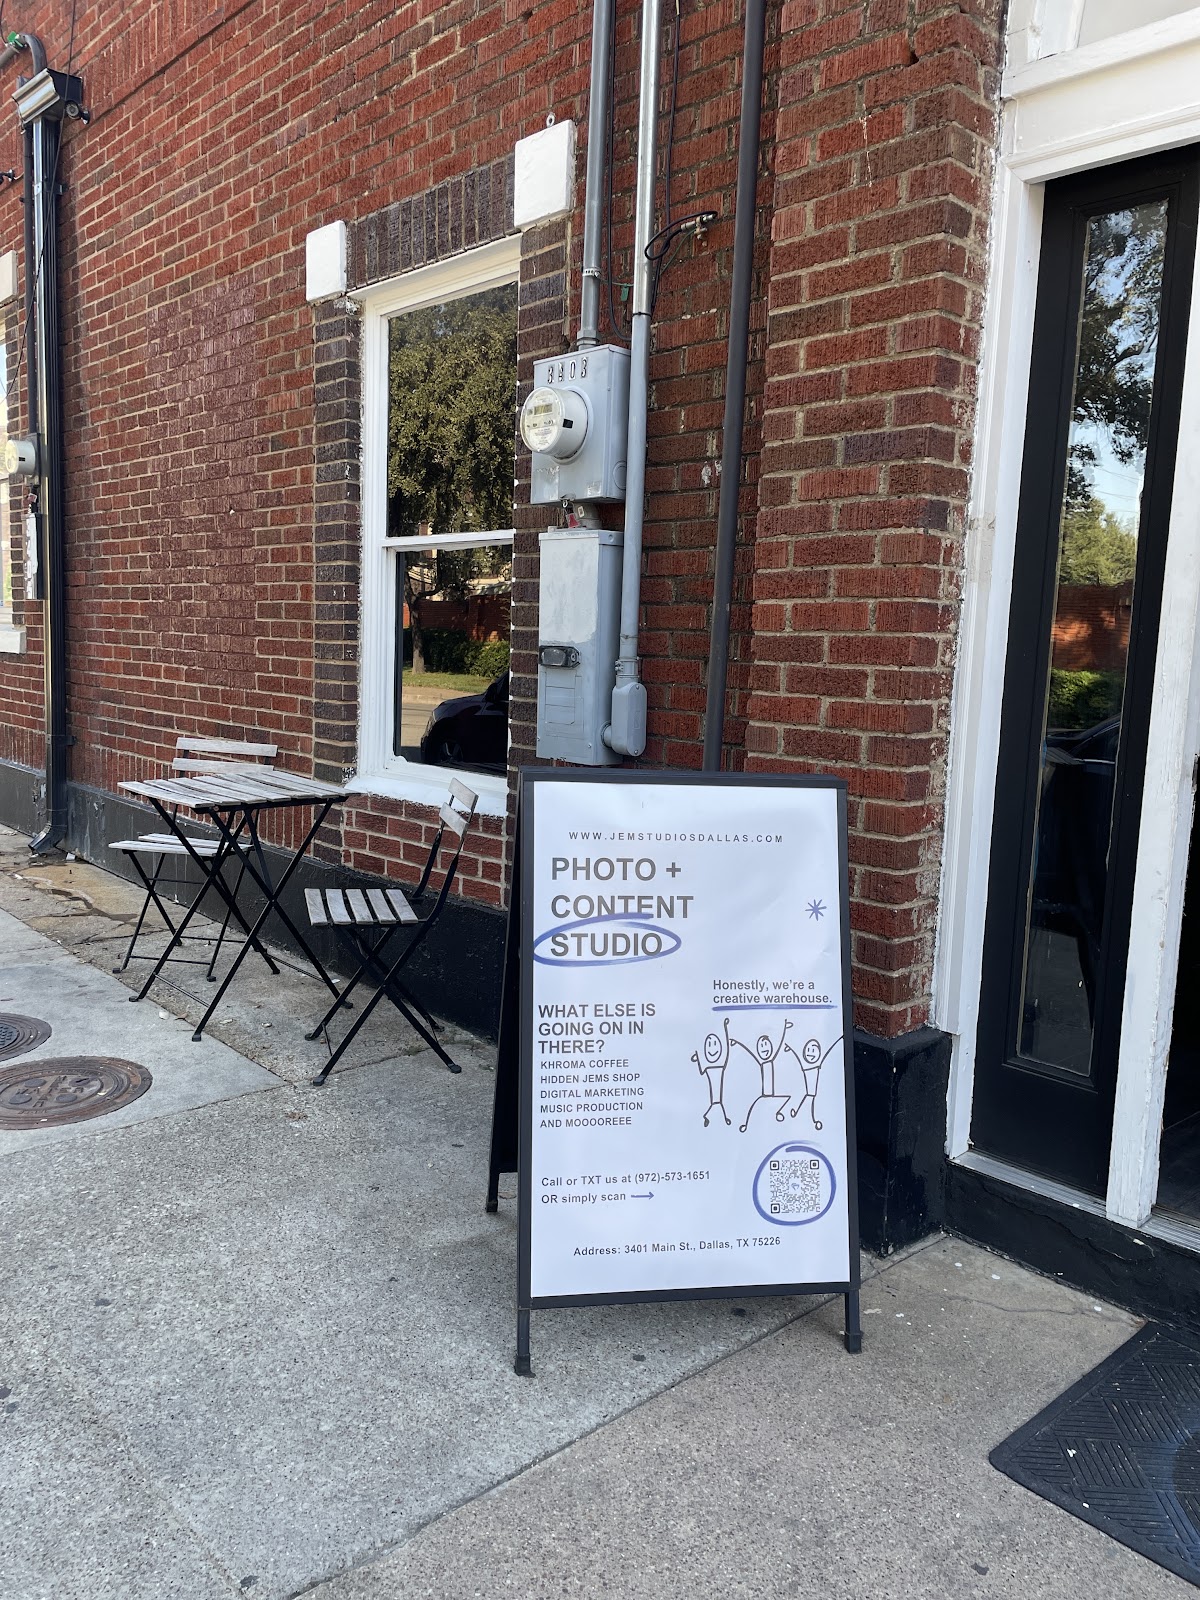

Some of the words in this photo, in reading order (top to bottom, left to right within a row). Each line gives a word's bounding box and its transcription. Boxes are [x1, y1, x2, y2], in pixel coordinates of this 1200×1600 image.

[568, 831, 783, 843] WWW.JEMSTUDIOSDALLAS.COM
[551, 857, 656, 882] PHOTO
[665, 861, 682, 879] +
[551, 894, 694, 919] CONTENT
[550, 932, 663, 957] STUDIO
[713, 979, 769, 992] Honestly,
[808, 982, 815, 990] a
[713, 993, 761, 1004] creative
[764, 993, 833, 1004] warehouse.
[538, 1004, 589, 1018] WHAT
[594, 1003, 636, 1018] ELSE
[641, 1003, 656, 1017] IS
[538, 1022, 594, 1036] GOING
[599, 1021, 623, 1035] ON
[628, 1021, 644, 1034] IN
[538, 1039, 605, 1054] THERE?
[540, 1060, 586, 1070] KHROMA
[589, 1059, 629, 1069] COFFEE
[540, 1074, 579, 1084] HIDDEN
[582, 1073, 610, 1083] JEMS
[612, 1073, 641, 1082] SHOP
[540, 1089, 581, 1099] DIGITAL
[584, 1087, 645, 1098] MARKETING
[540, 1103, 573, 1114] MUSIC
[576, 1101, 643, 1113] PRODUCTION
[540, 1119, 562, 1128] AND
[565, 1116, 632, 1128] MOOOOREEE
[541, 1177, 563, 1187] Call
[566, 1178, 578, 1186] or
[581, 1175, 602, 1185] TXT
[605, 1176, 618, 1184] us
[621, 1174, 632, 1183] at
[634, 1170, 711, 1184] (972)-573-1651
[541, 1194, 558, 1204] OR
[561, 1193, 598, 1205] simply
[601, 1192, 626, 1202] scan
[573, 1246, 621, 1256] Address:
[624, 1244, 648, 1254] 3401
[651, 1243, 676, 1253] Main
[699, 1240, 733, 1250] Dallas,
[736, 1238, 750, 1248] TX
[752, 1236, 781, 1247] 75226
